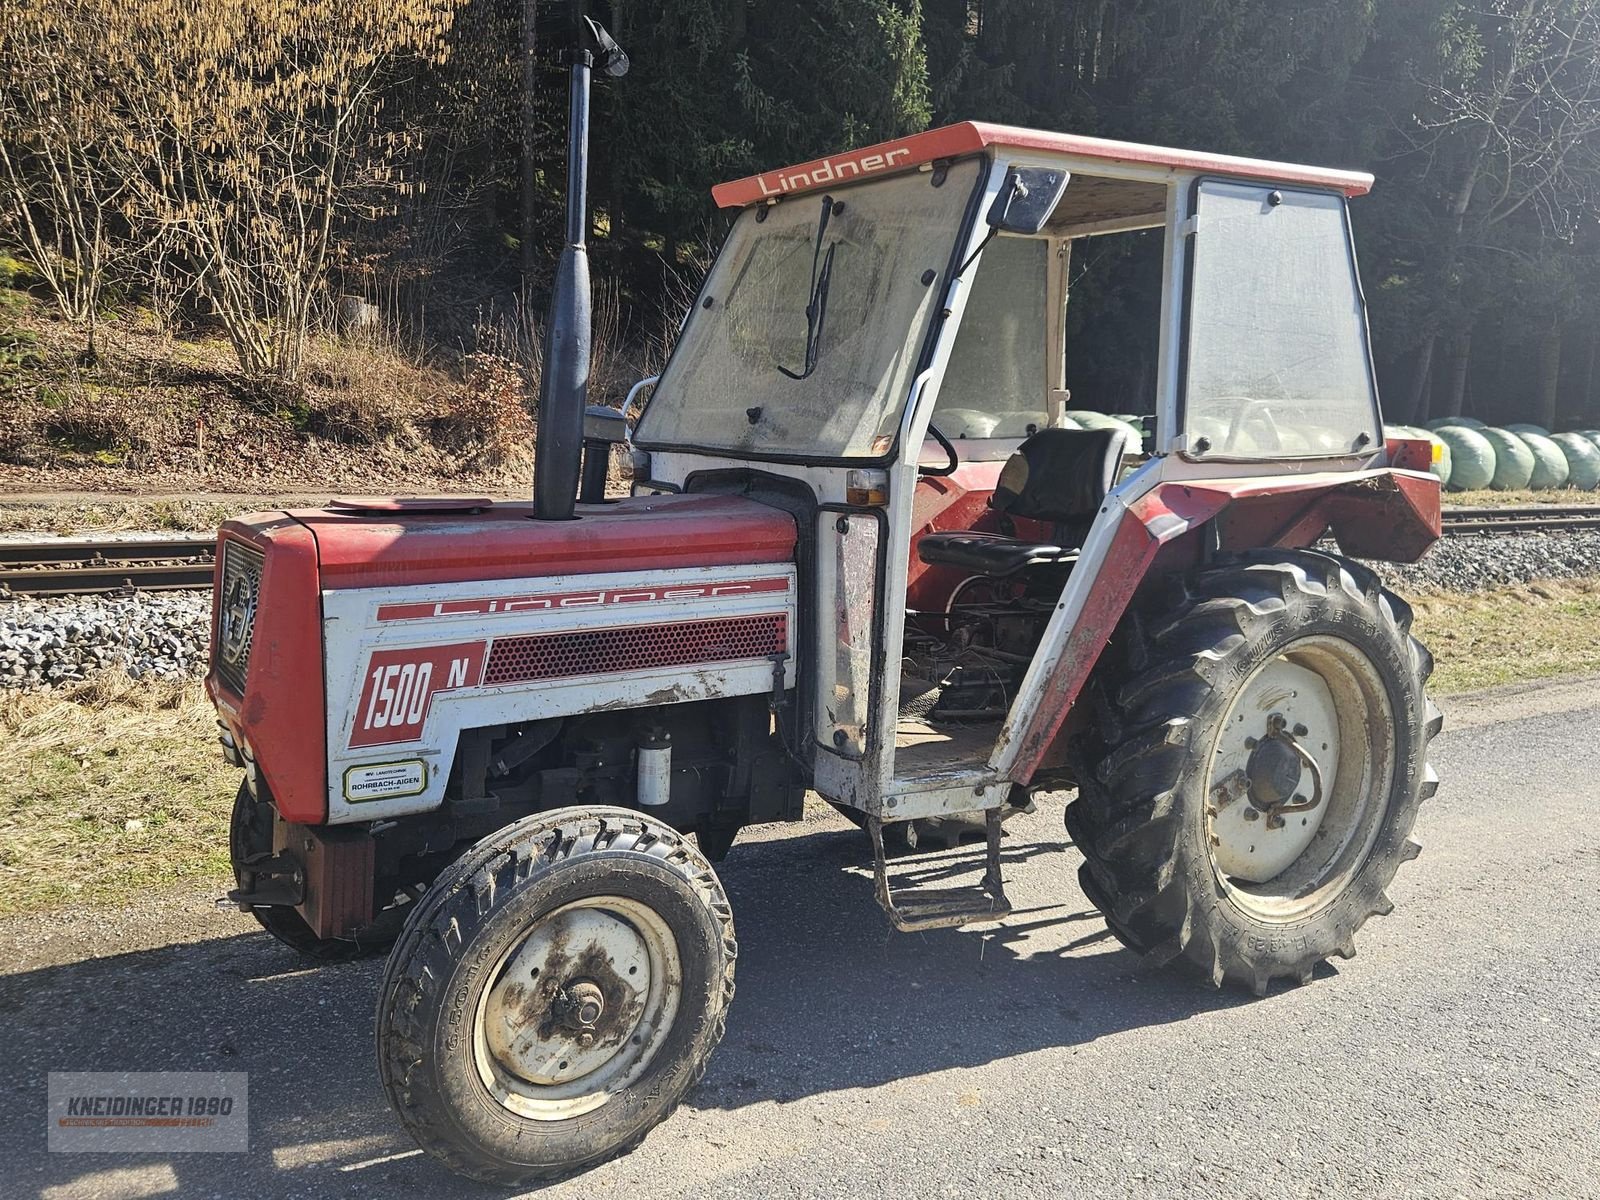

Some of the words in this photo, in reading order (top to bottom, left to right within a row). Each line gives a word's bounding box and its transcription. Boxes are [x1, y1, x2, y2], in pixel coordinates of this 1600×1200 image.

[757, 147, 910, 195] Lindner
[433, 585, 751, 617] Lindner
[364, 662, 433, 730] 1500
[446, 657, 470, 688] N
[352, 777, 420, 791] ROHRBACH-AIGEN
